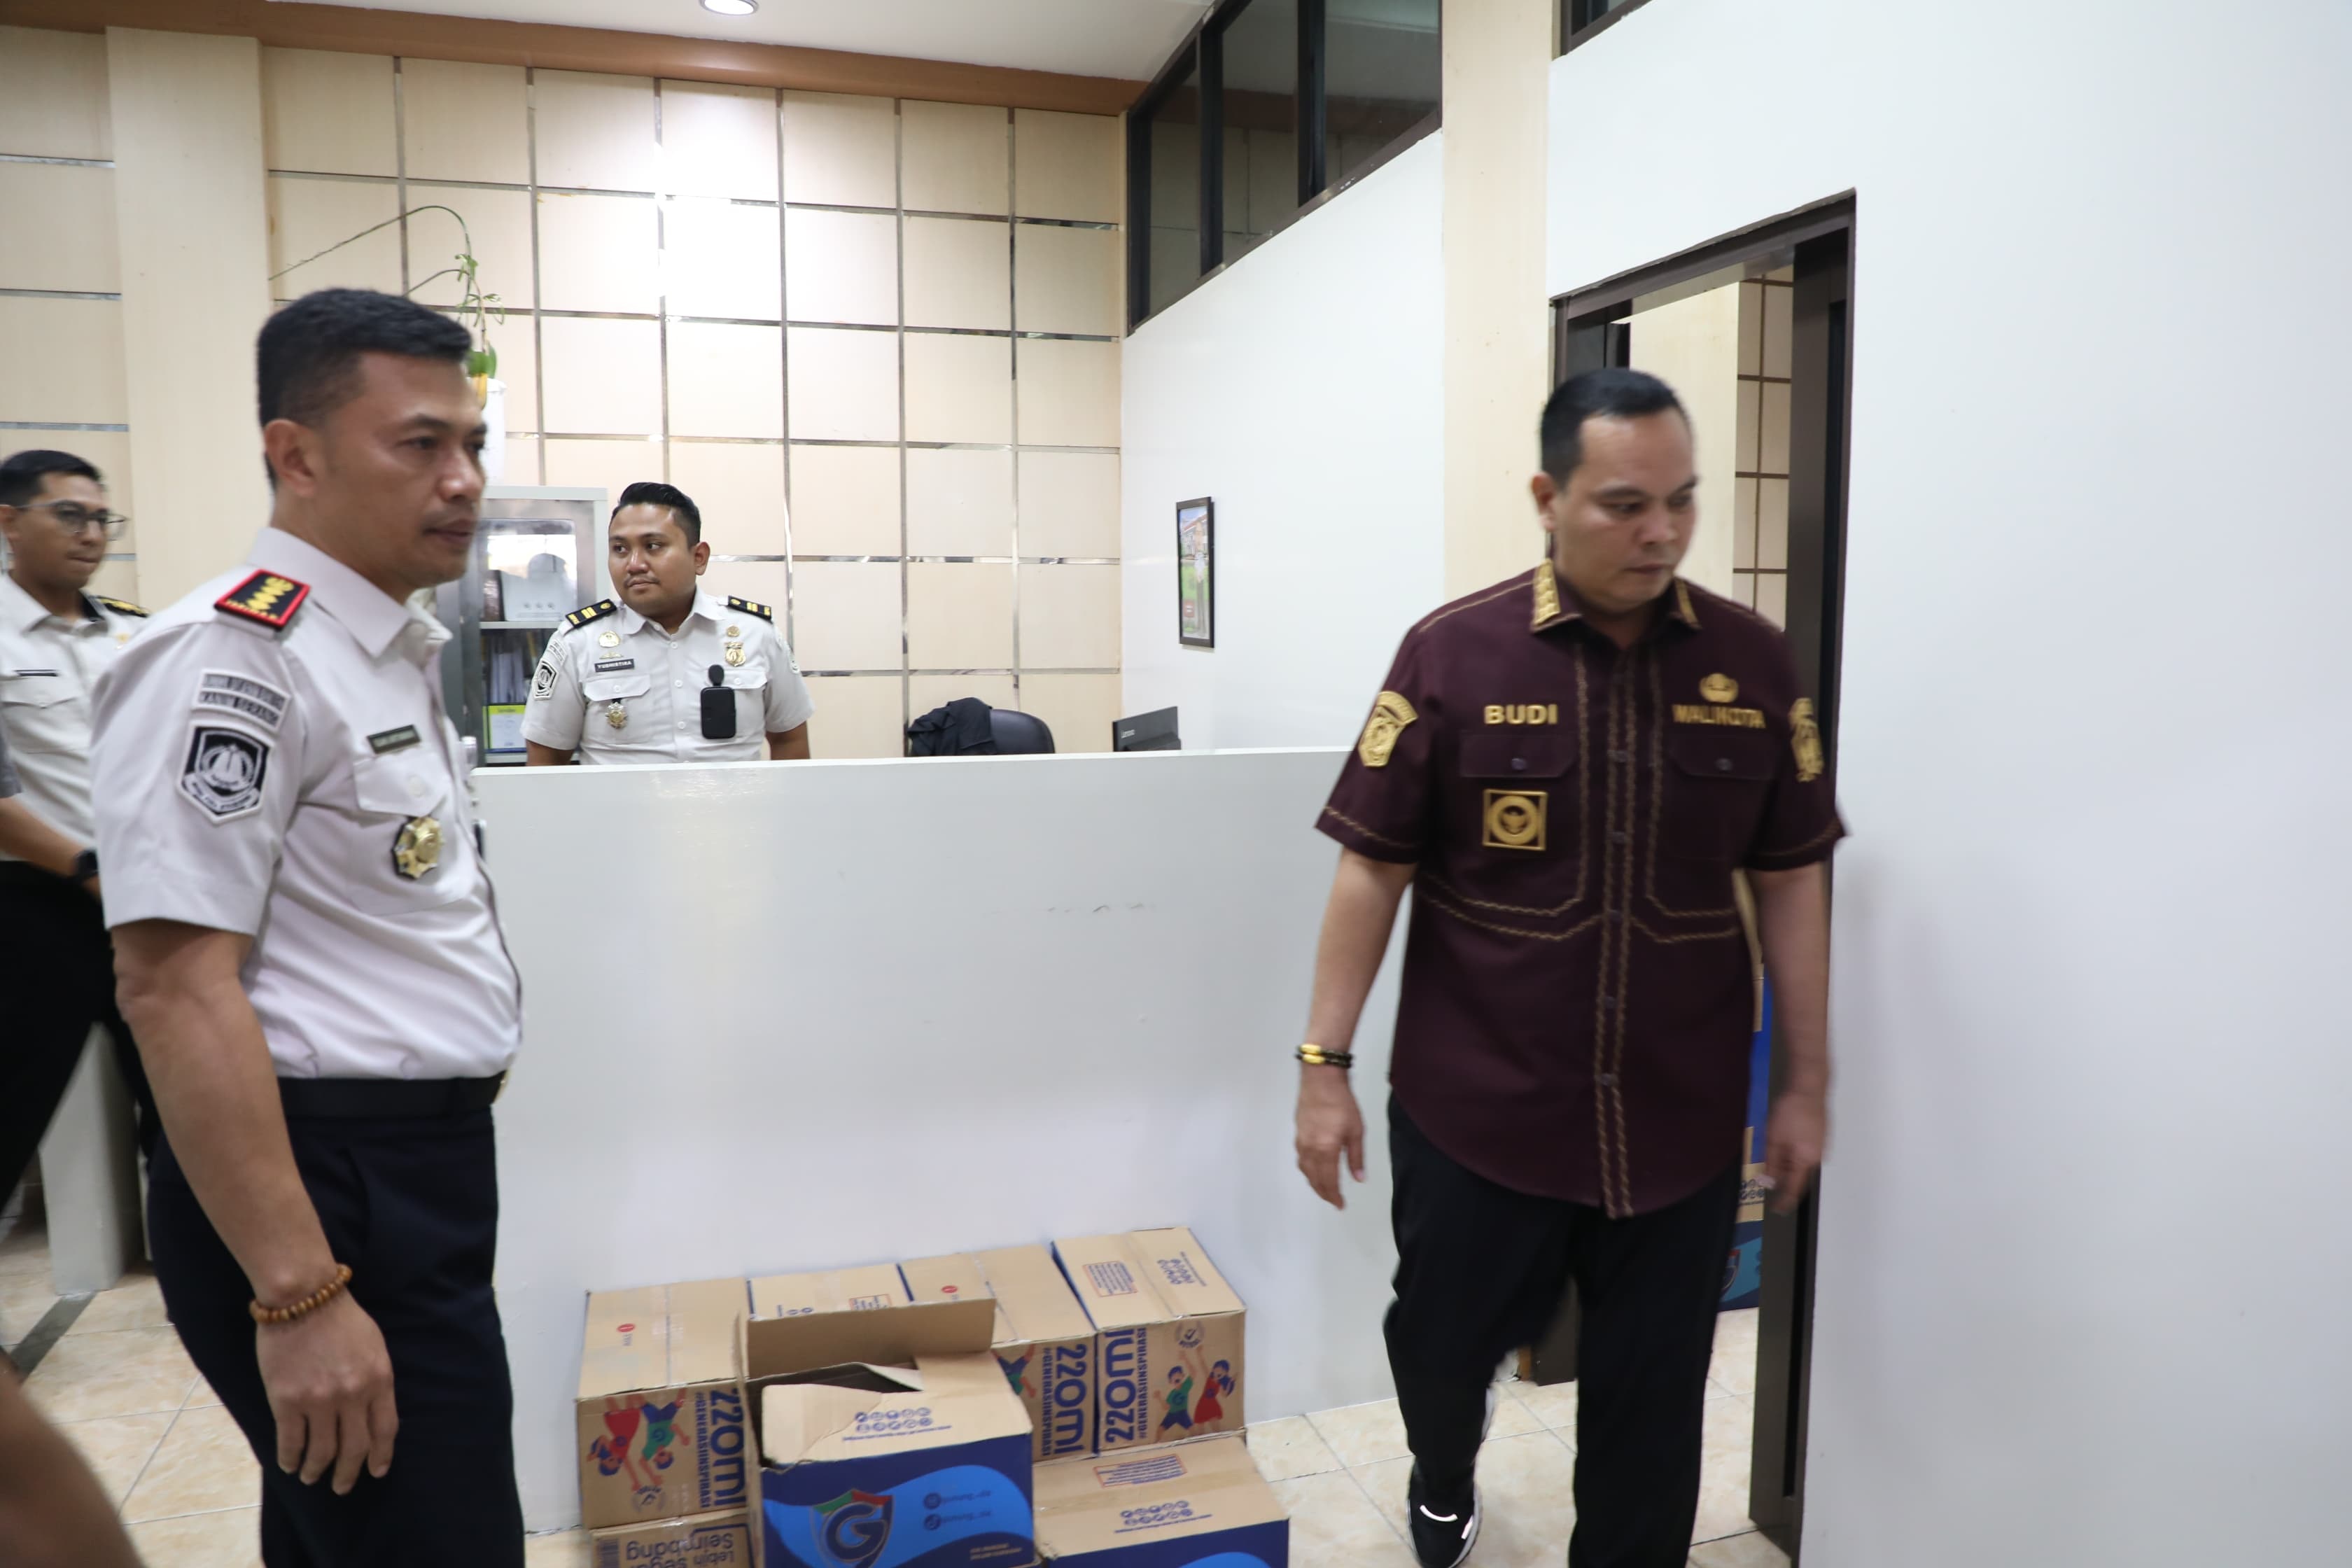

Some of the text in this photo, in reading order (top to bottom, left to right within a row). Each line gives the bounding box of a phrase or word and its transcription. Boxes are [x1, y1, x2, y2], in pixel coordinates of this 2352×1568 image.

[1484, 704, 1558, 724] BUDI
[1672, 704, 1766, 728] WALIKOTA
[1042, 1348, 1053, 1455] #GENERASIINSPIRASI
[1054, 1343, 1087, 1454] 220ml
[1105, 1329, 1136, 1443] 220ml
[1137, 1328, 1147, 1438] #GENERASIINSPIRASI
[695, 1392, 710, 1508] #GENERASIINSPIRASI
